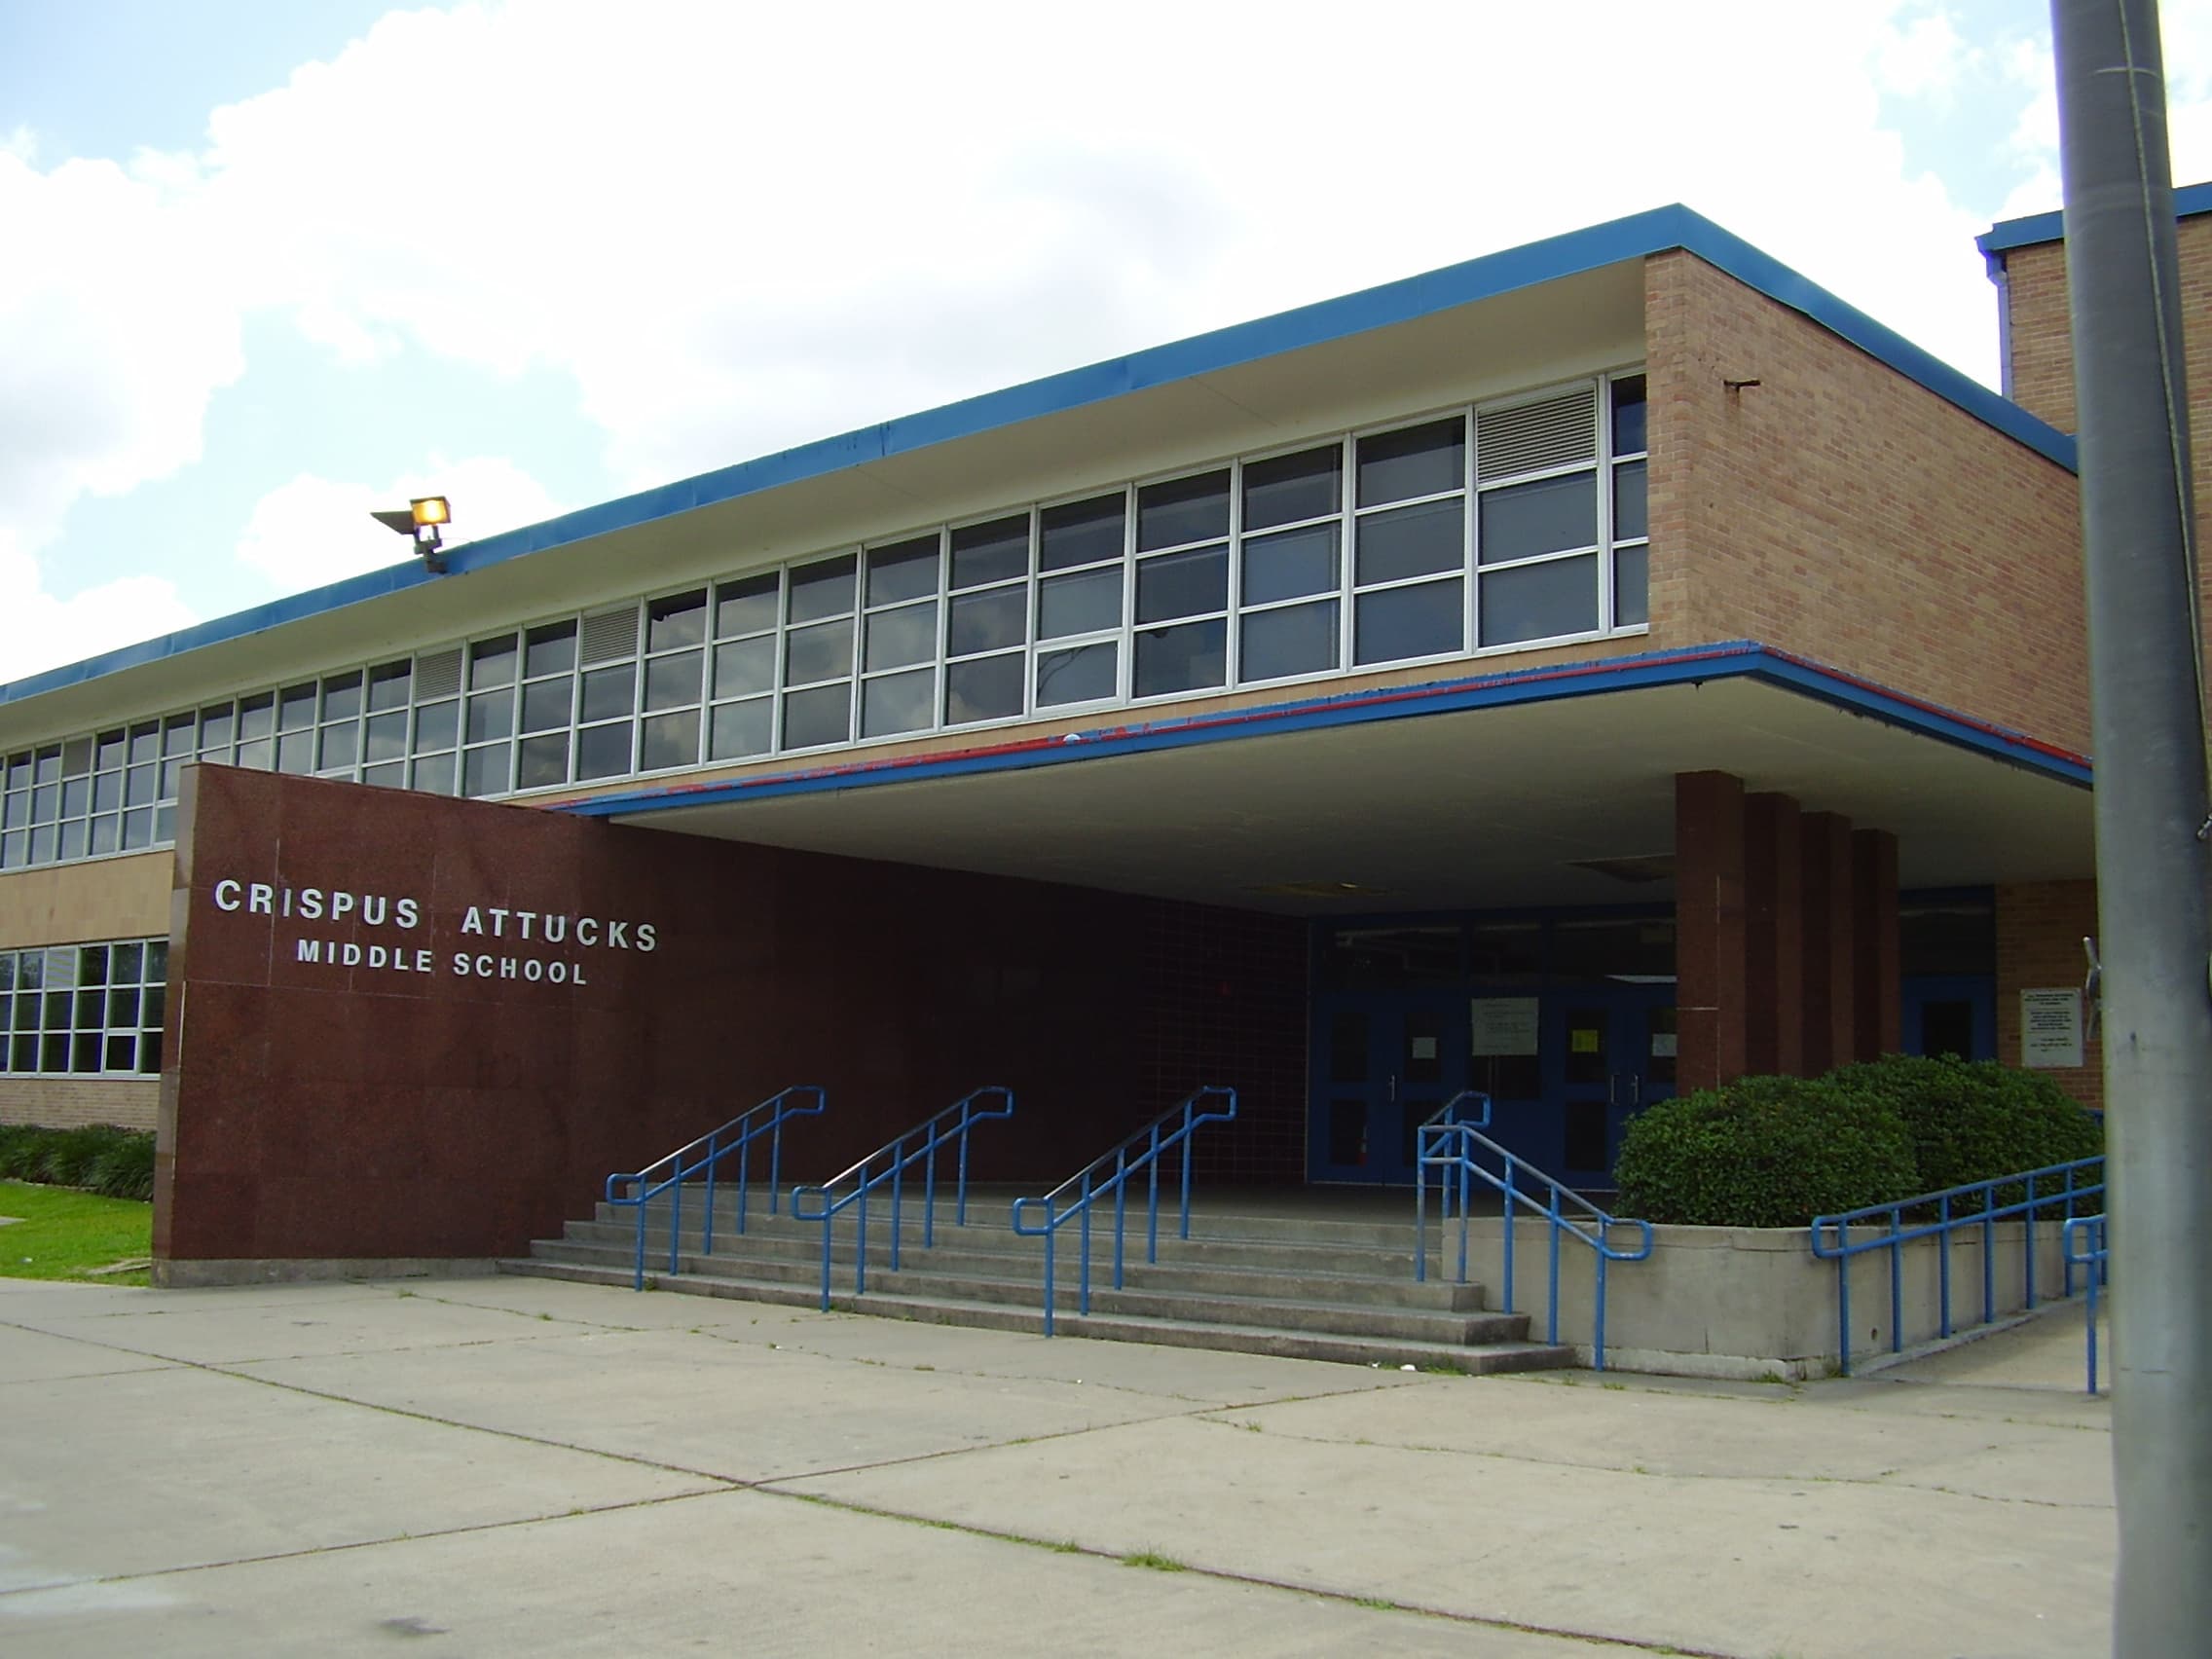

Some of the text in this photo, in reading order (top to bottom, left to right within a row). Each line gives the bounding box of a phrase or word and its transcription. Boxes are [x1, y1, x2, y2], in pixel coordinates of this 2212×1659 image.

[214, 880, 657, 952] CRISPUS ATTUCKS
[297, 940, 587, 984] MIDDLE SCHOOL
